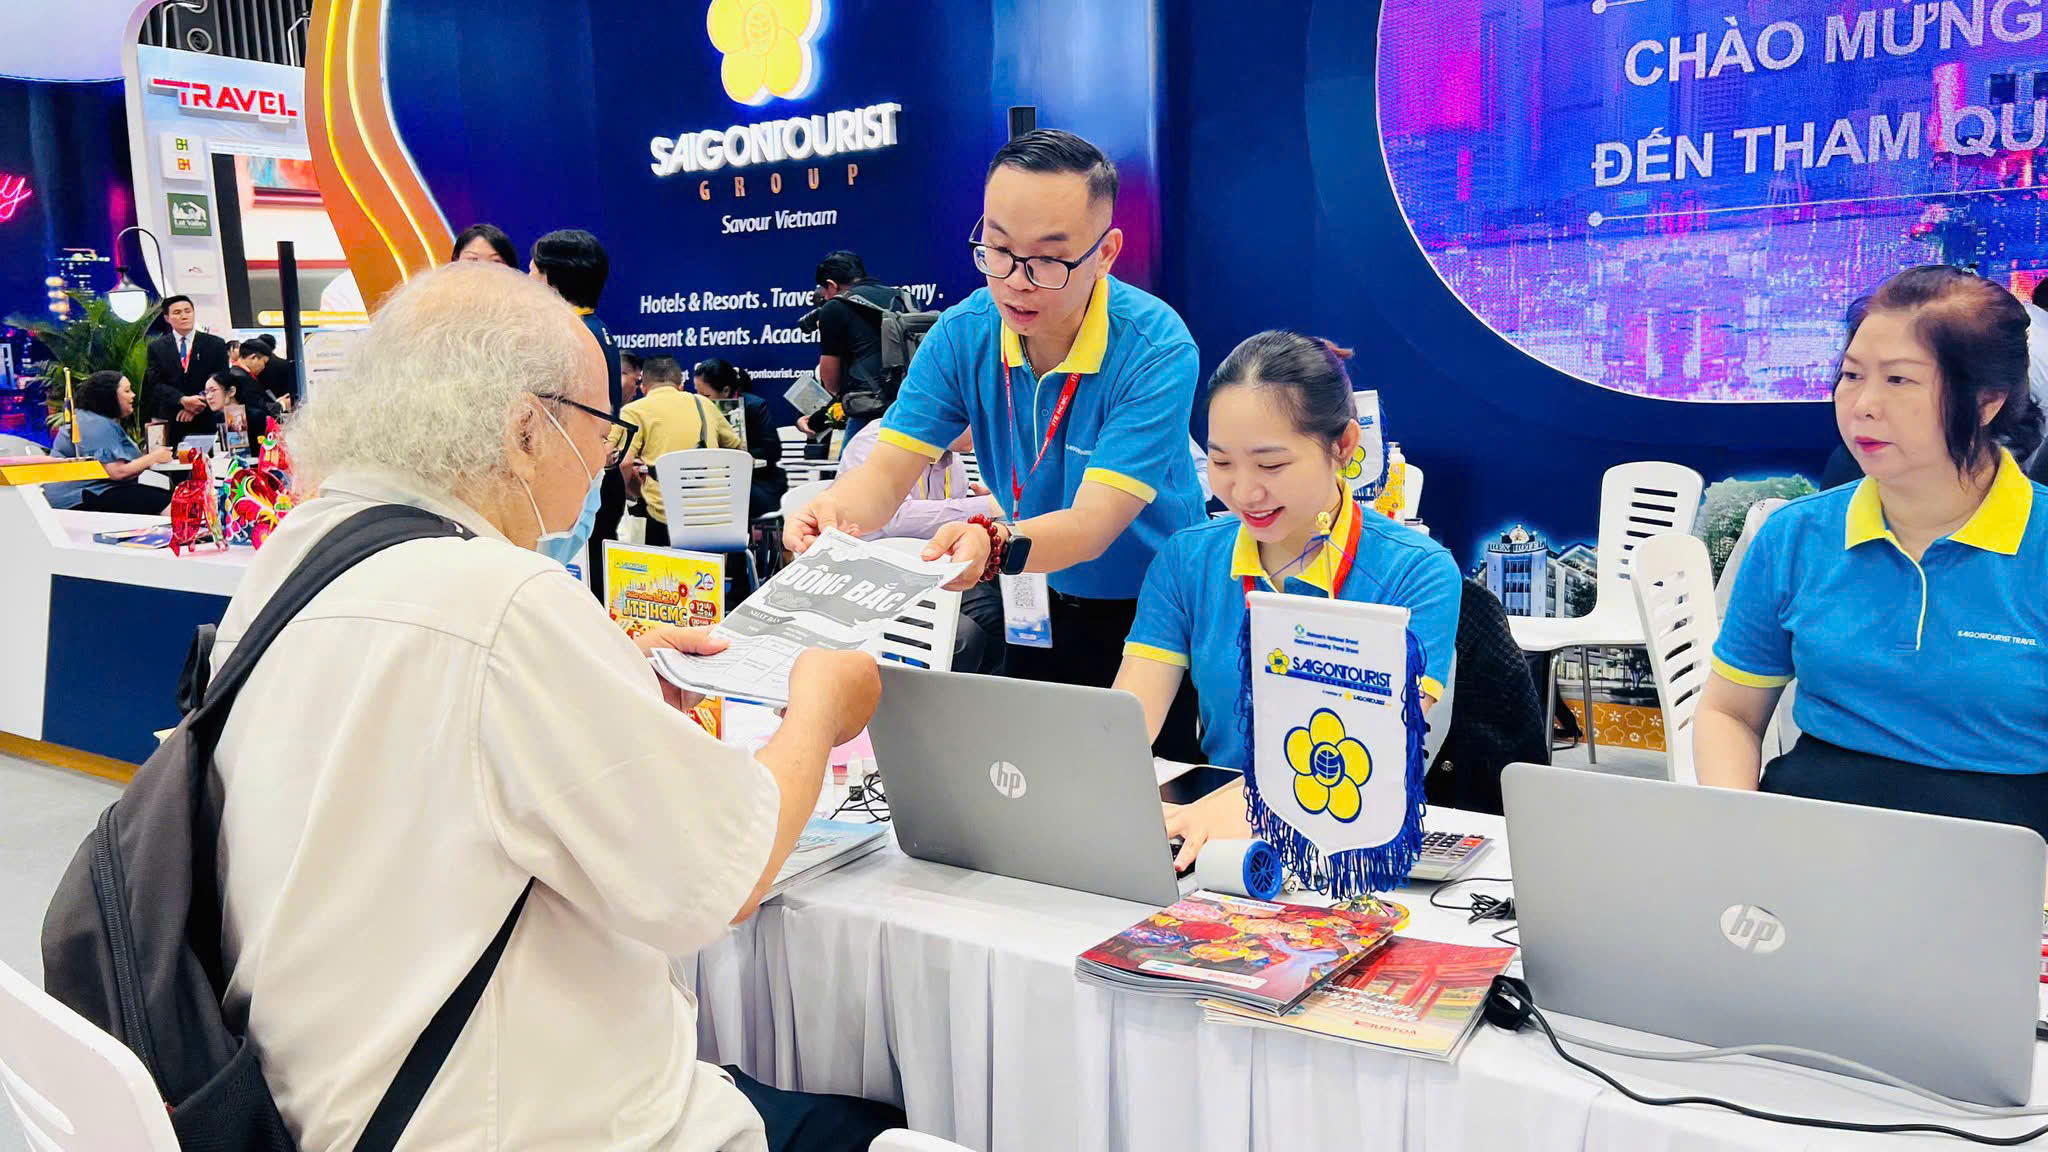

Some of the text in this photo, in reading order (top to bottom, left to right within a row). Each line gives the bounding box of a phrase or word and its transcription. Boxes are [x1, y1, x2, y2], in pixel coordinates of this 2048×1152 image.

[1624, 16, 1804, 86] CHÀO
[152, 78, 298, 117] TRAVEL
[650, 102, 902, 176] SAIGONTOURIST
[1591, 128, 1713, 188] ĐẾN
[1733, 110, 1921, 174] THAM
[699, 163, 859, 201] GROUP
[721, 209, 838, 235] Savour Vietnam
[640, 292, 686, 314] Hotels
[688, 291, 700, 312] &
[702, 290, 760, 311] Resorts
[770, 287, 815, 308] Trave
[685, 327, 698, 347] &
[700, 326, 751, 346] Events
[1488, 540, 1547, 552] REX HOTEL
[776, 562, 907, 612] ĐÔNG BẮC
[648, 602, 688, 625] HCMC
[1957, 630, 2038, 646] SAIGONTOURIST TRAVEL
[1292, 656, 1392, 688] SAIGONTOURIST
[996, 760, 1021, 799] hp
[1728, 904, 1778, 952] hp
